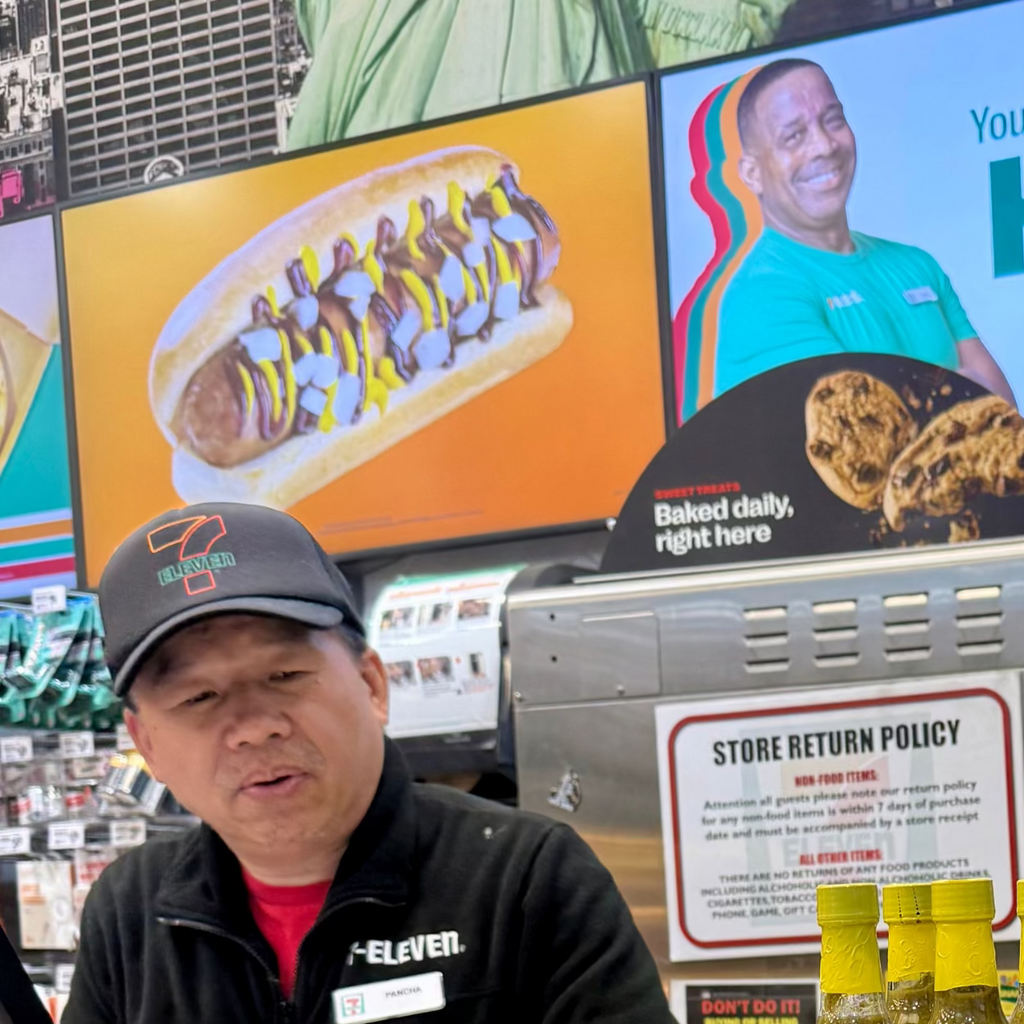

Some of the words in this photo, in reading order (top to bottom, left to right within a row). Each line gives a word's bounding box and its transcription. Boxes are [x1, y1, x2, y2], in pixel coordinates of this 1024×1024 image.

[654, 496, 729, 527] Baked
[732, 491, 795, 520] daily,
[655, 525, 712, 556] right
[714, 523, 772, 547] here
[147, 515, 227, 596] 7
[712, 736, 782, 765] STORE
[788, 727, 874, 760] RETURN
[881, 719, 961, 751] POLICY
[794, 772, 844, 787] NON-FOOD
[846, 769, 880, 783] ITEMS:
[703, 796, 757, 811] Attention
[760, 796, 773, 808] all
[776, 793, 810, 808] guests
[813, 789, 847, 804] please
[851, 788, 877, 799] note
[880, 787, 900, 796] our
[903, 783, 940, 795] return
[943, 779, 977, 795] policy
[701, 815, 718, 827] for
[720, 816, 739, 827] any
[742, 809, 791, 823] non-food
[793, 806, 825, 819] items
[828, 806, 837, 817] is
[840, 803, 874, 816] within
[877, 802, 884, 812] 7
[887, 799, 913, 813] days
[915, 799, 928, 810] of
[930, 795, 980, 811] purchase
[705, 829, 730, 841] date
[733, 828, 752, 839] and
[755, 826, 783, 838] must
[786, 824, 799, 835] be
[801, 818, 876, 836] accompanied
[879, 816, 892, 831] by
[895, 819, 902, 827] a
[906, 814, 934, 826] store
[938, 810, 979, 827] receipt
[719, 874, 750, 884] THERE
[752, 872, 771, 882] ARE
[773, 871, 789, 880] NO
[791, 867, 838, 879] RETURNS
[840, 866, 853, 875] OF
[856, 864, 877, 874] ANY
[880, 861, 910, 873] FOOD
[912, 858, 969, 871] PRODUCTS
[799, 853, 816, 865] ALL
[817, 850, 849, 864] OTHER
[850, 849, 882, 862] ITEMS:
[385, 986, 422, 998] PANCHA
[701, 999, 749, 1015] DON'T
[753, 1000, 777, 1015] DO
[781, 999, 800, 1014] IT!
